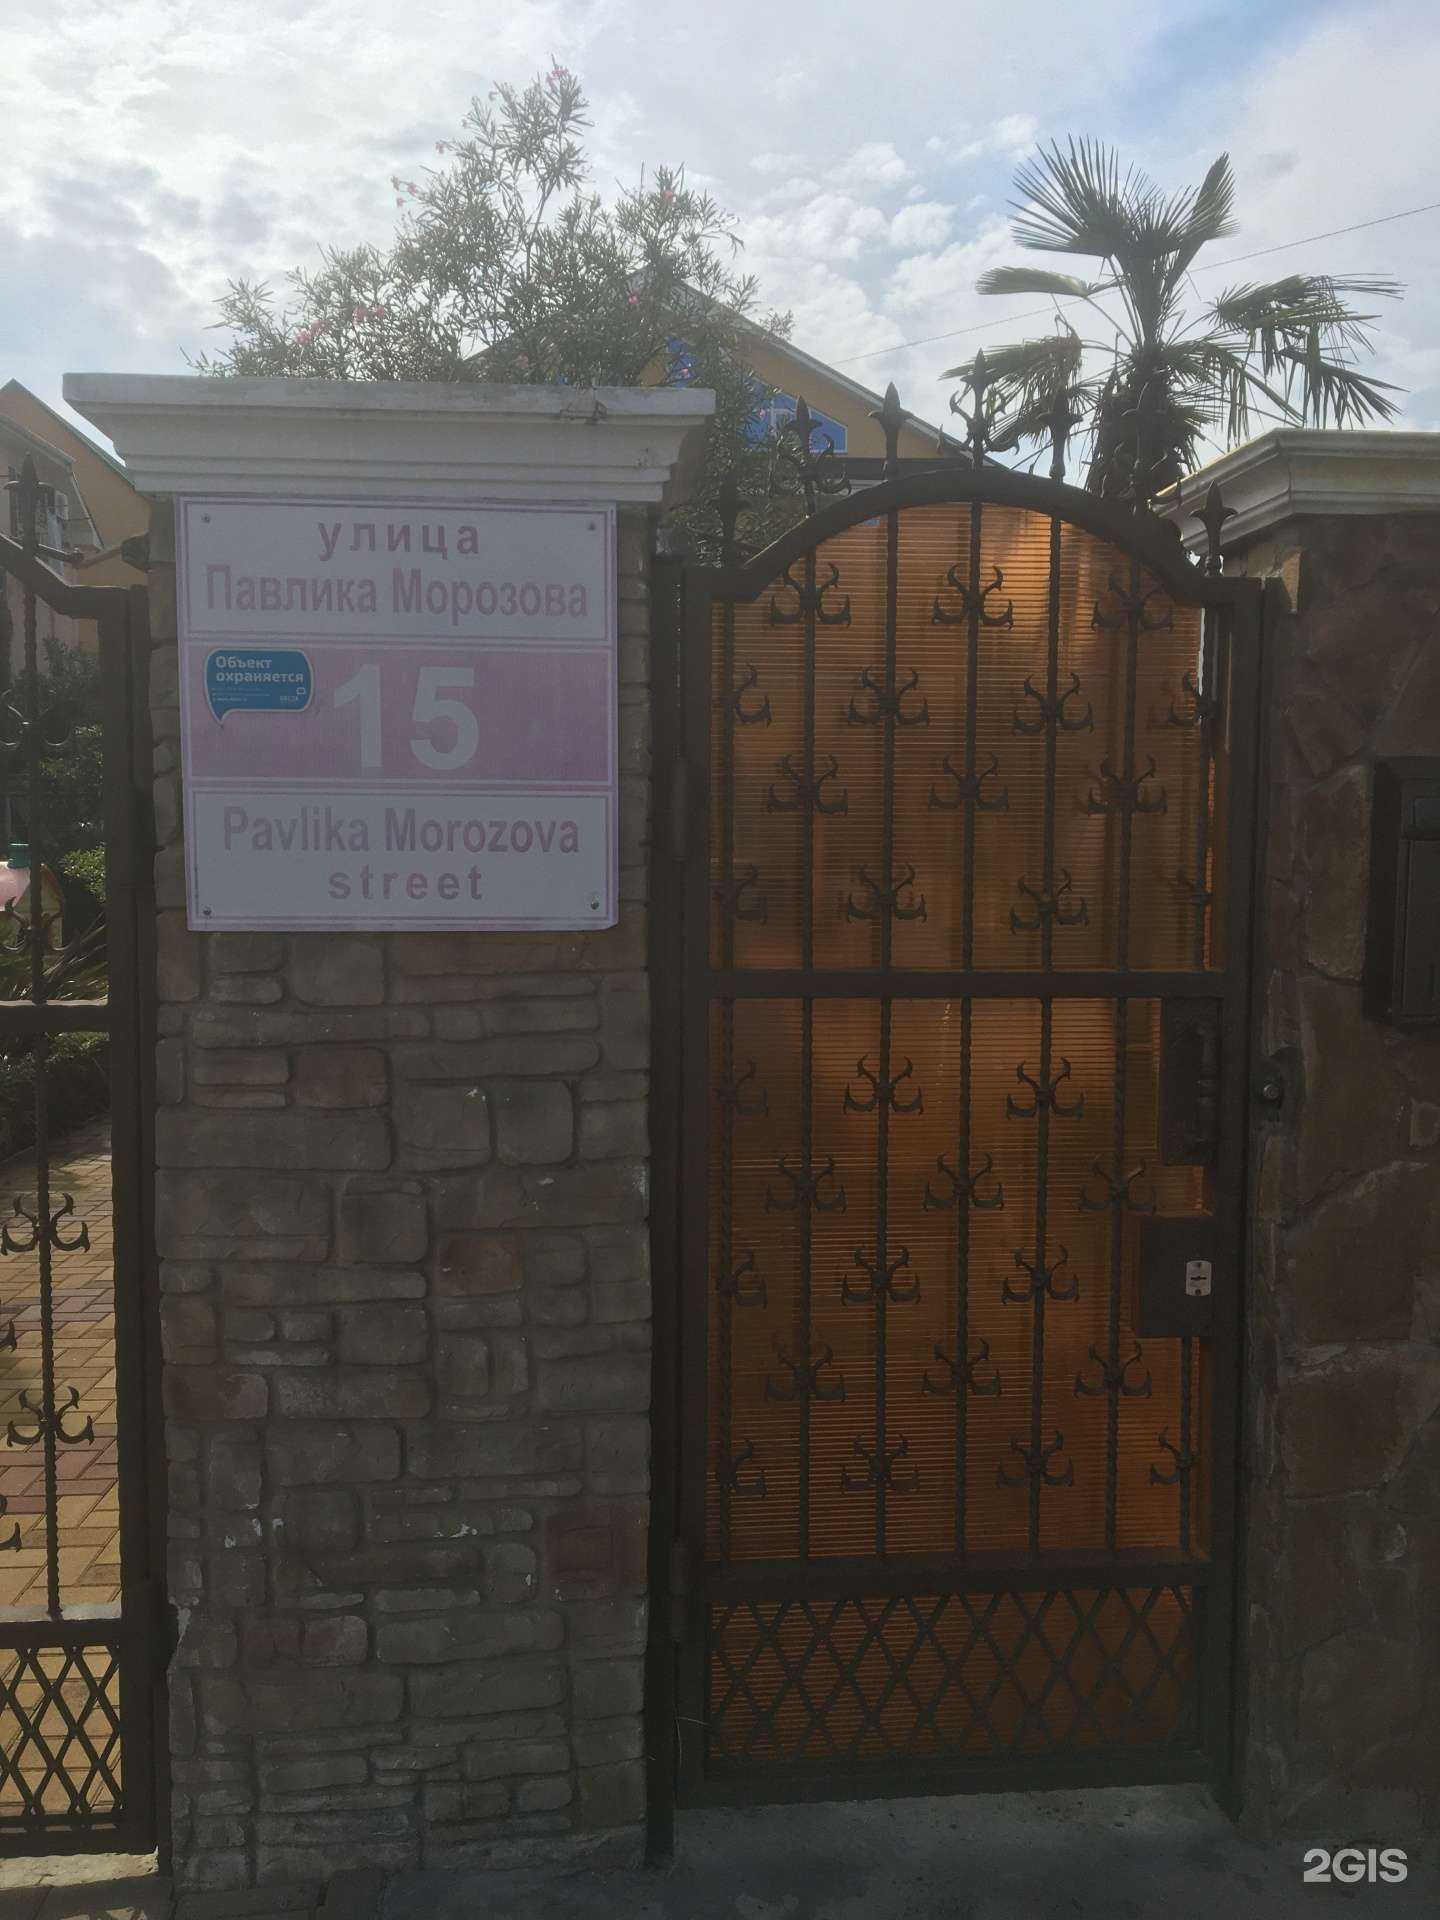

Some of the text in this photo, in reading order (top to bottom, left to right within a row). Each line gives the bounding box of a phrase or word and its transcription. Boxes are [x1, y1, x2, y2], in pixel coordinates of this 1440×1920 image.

[317, 520, 480, 562] улица
[206, 563, 588, 625] Павлика Морозова
[215, 655, 272, 669] Объект
[215, 671, 304, 685] охраняется
[333, 663, 481, 770] 15
[223, 806, 580, 854] Pavlika Morozova
[328, 864, 483, 901] street
